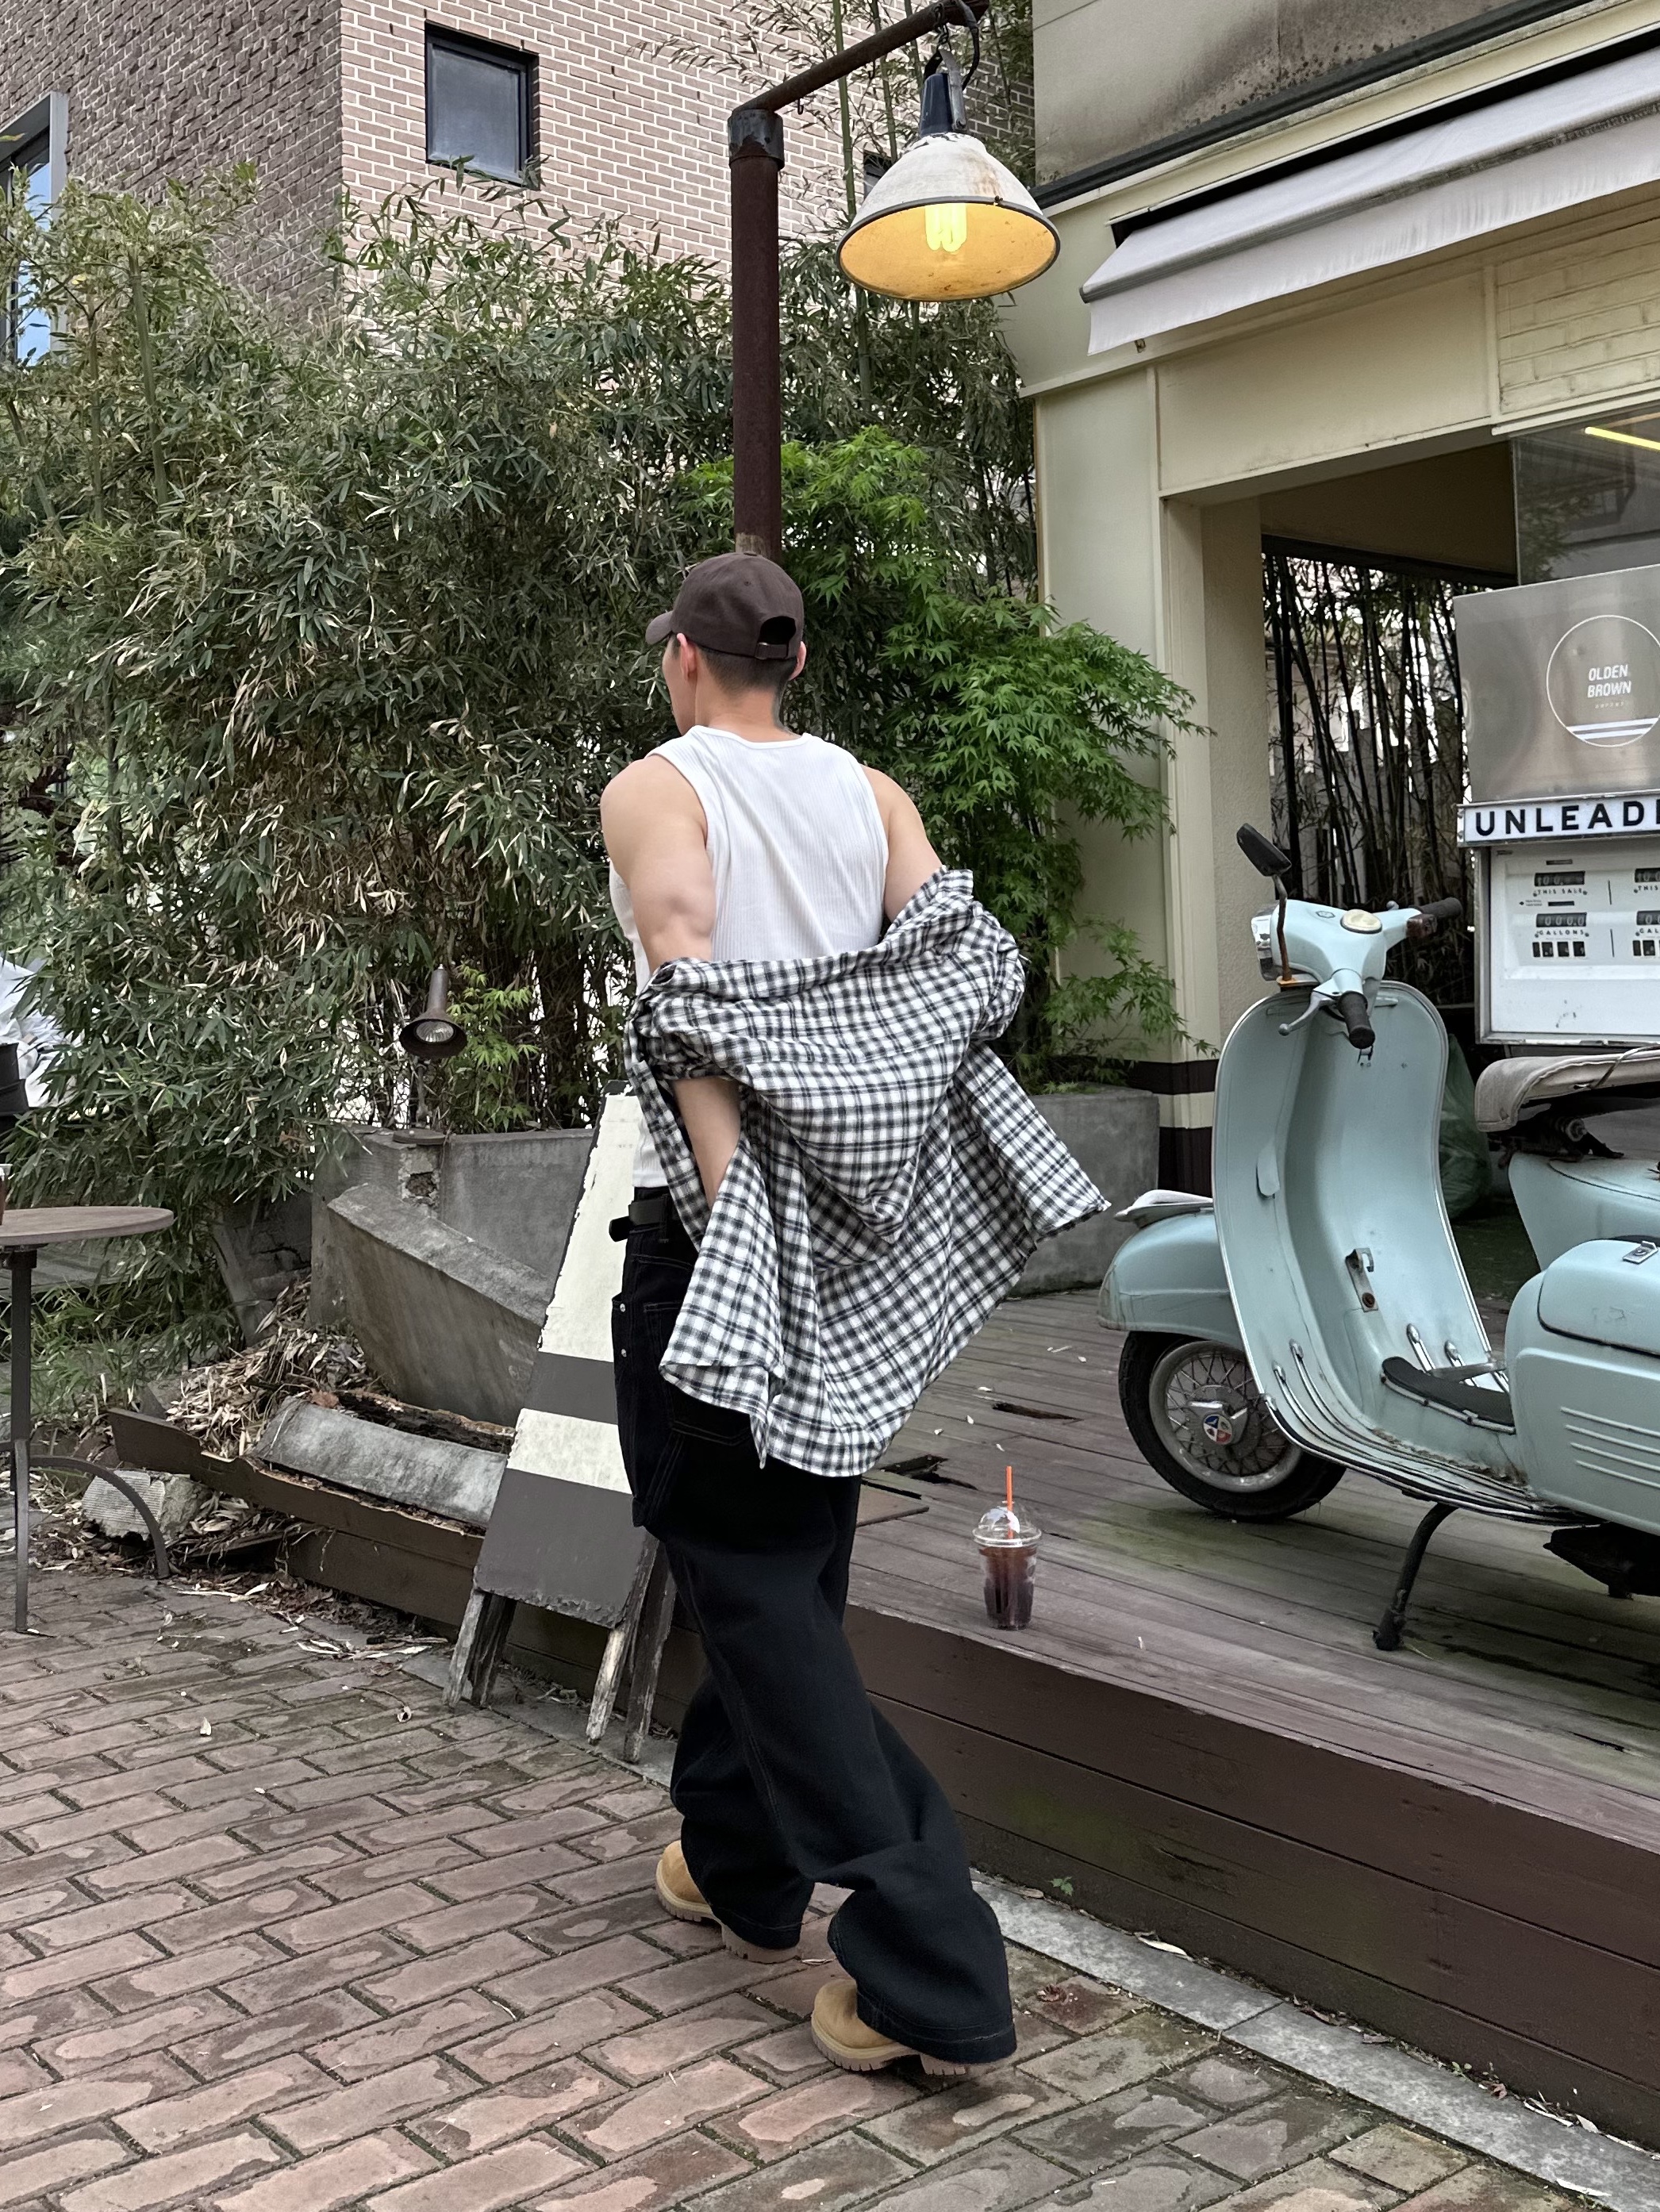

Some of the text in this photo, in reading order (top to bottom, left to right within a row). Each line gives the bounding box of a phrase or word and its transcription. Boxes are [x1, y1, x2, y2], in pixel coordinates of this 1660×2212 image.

[1589, 664, 1628, 681] OLDEN
[1588, 681, 1631, 697] BROWN
[1476, 800, 1660, 836] UNLEAD
